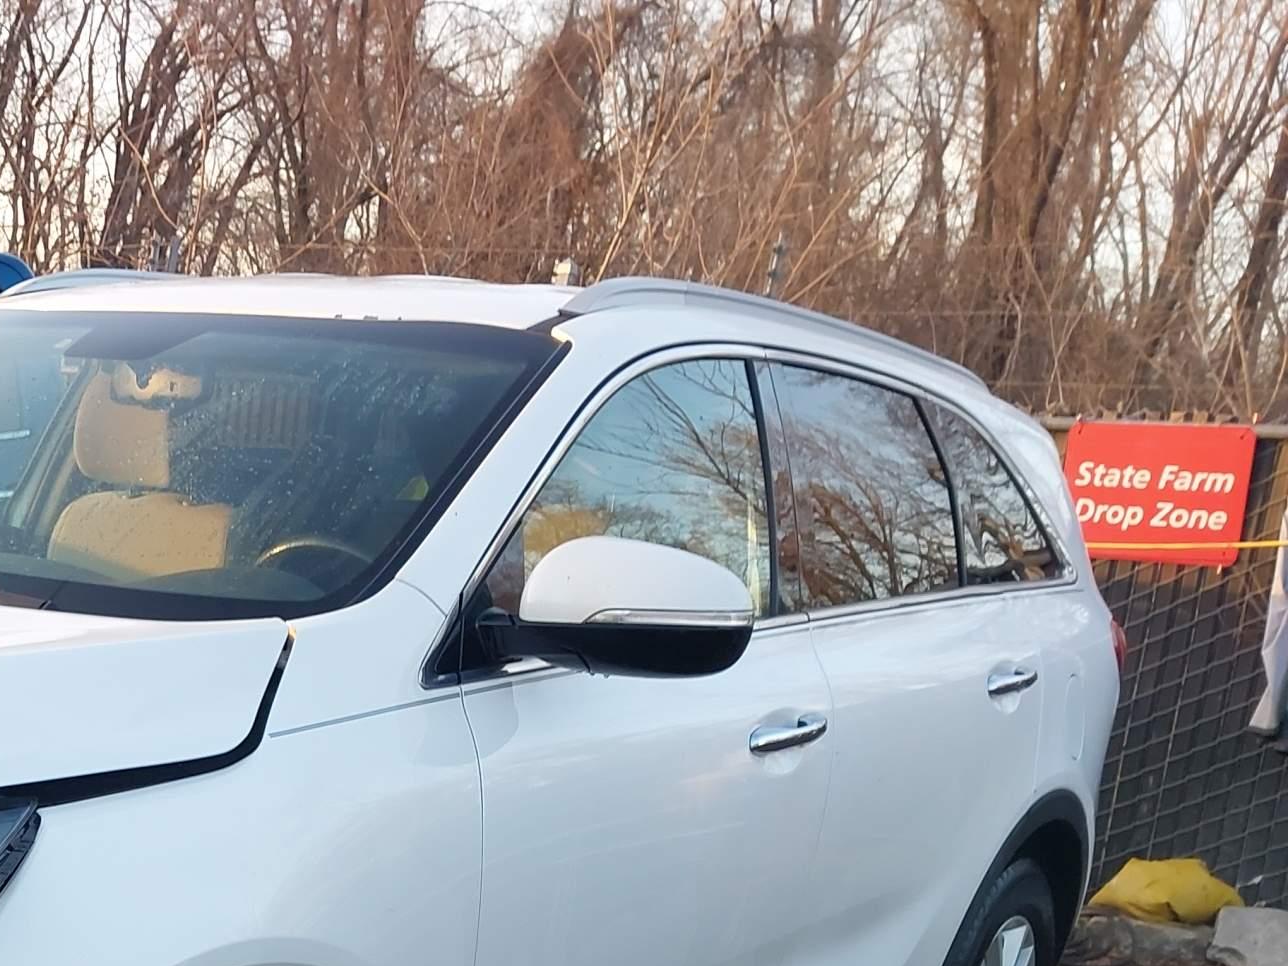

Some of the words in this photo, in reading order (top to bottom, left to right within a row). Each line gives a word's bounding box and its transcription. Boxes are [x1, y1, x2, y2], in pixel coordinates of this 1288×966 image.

[1074, 461, 1151, 489] State
[1158, 464, 1235, 493] Farm
[1074, 498, 1144, 531] Drop
[1149, 501, 1228, 531] Zone
